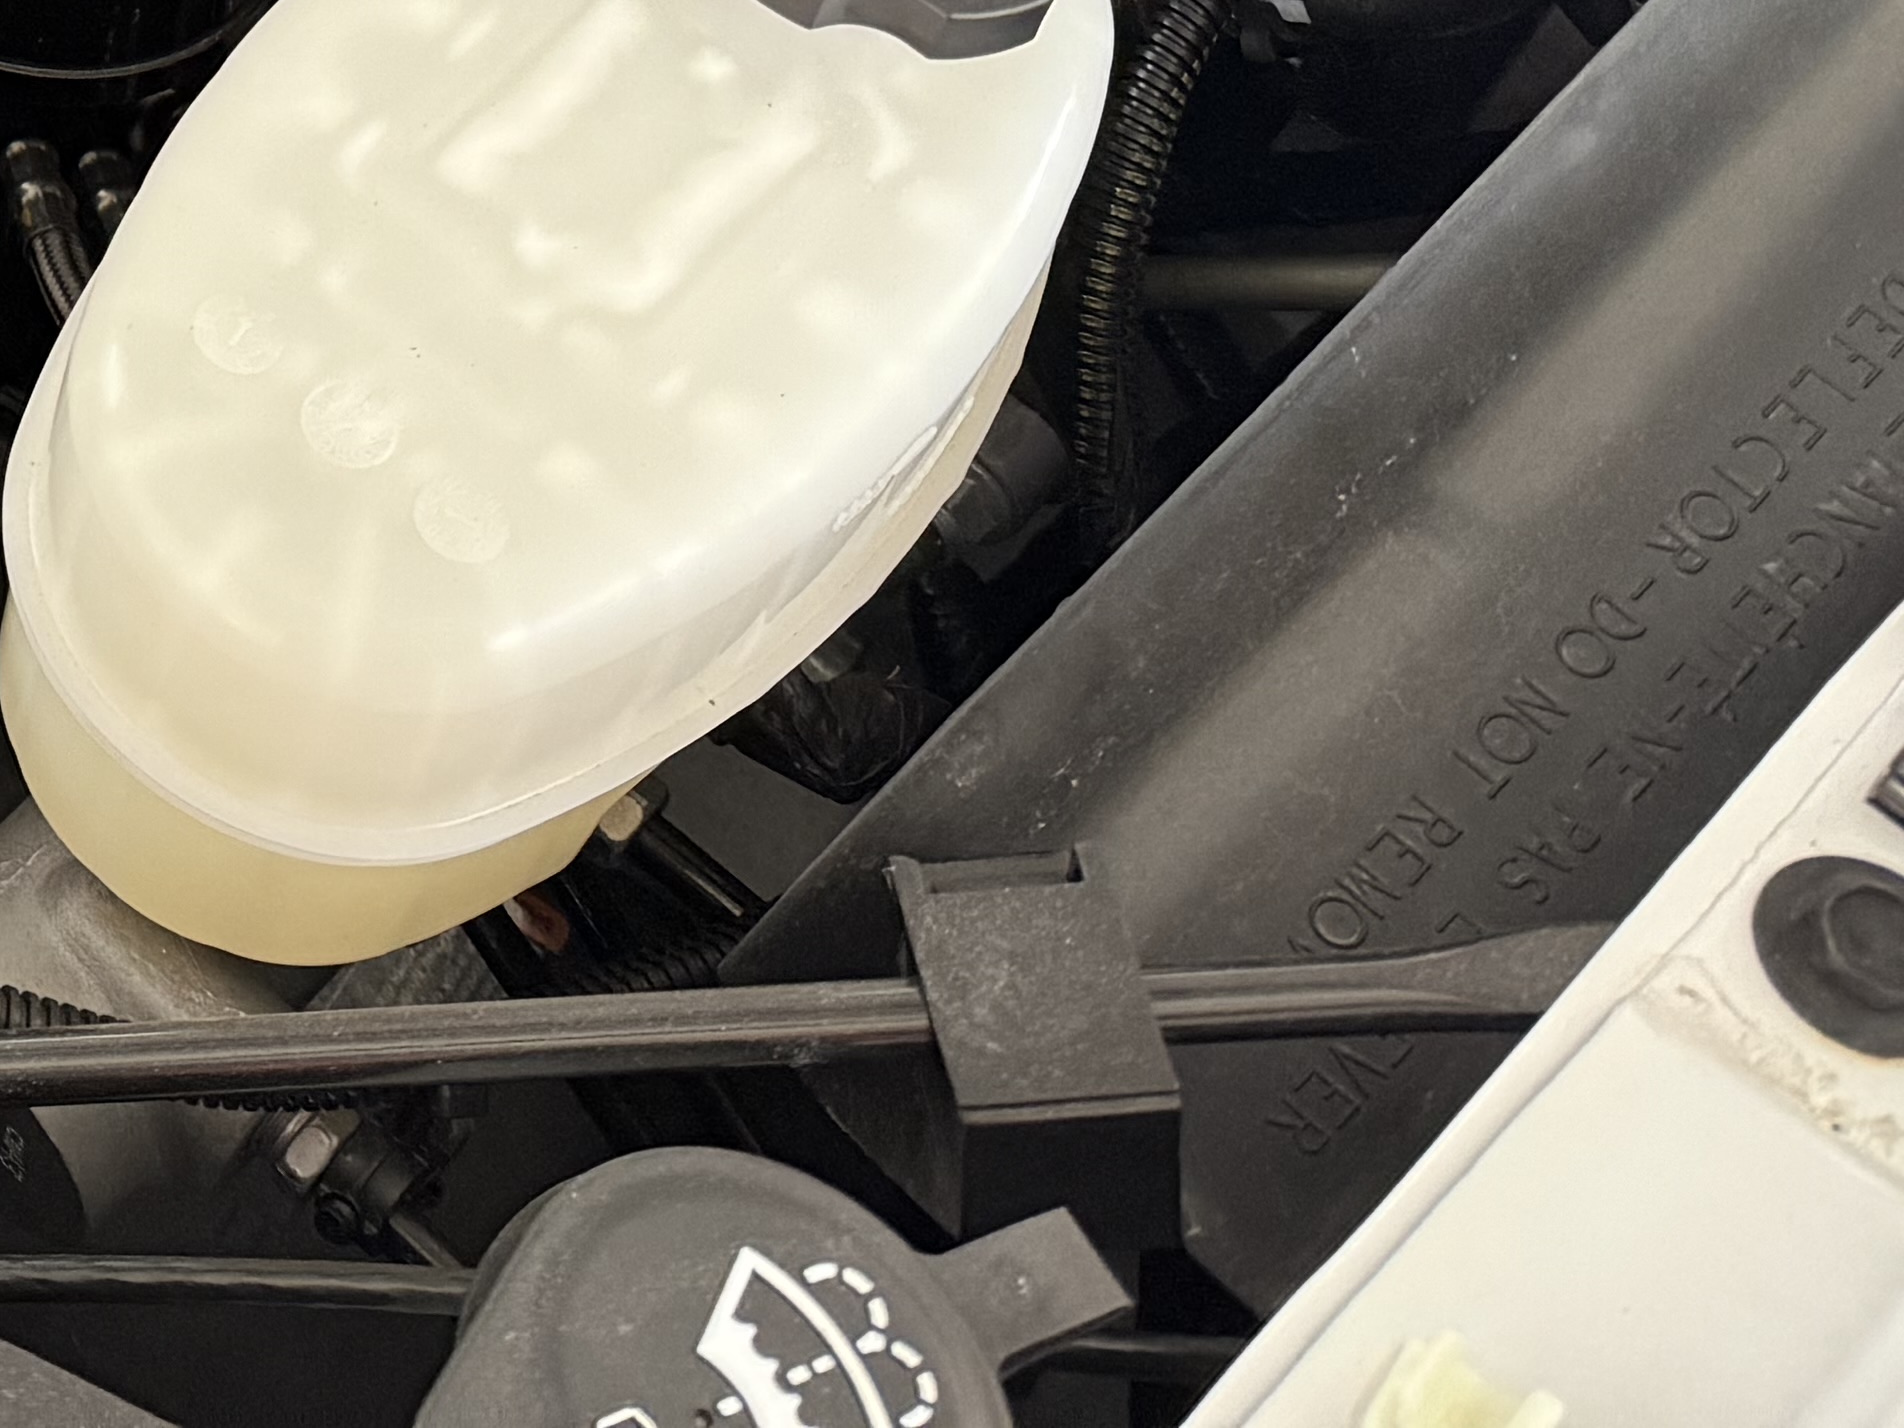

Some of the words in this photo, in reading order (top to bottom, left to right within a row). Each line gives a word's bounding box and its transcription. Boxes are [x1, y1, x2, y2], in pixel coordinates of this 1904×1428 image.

[1450, 673, 1572, 805] NOT
[1280, 789, 1465, 959] REMO
[1488, 798, 1604, 913] PAS
